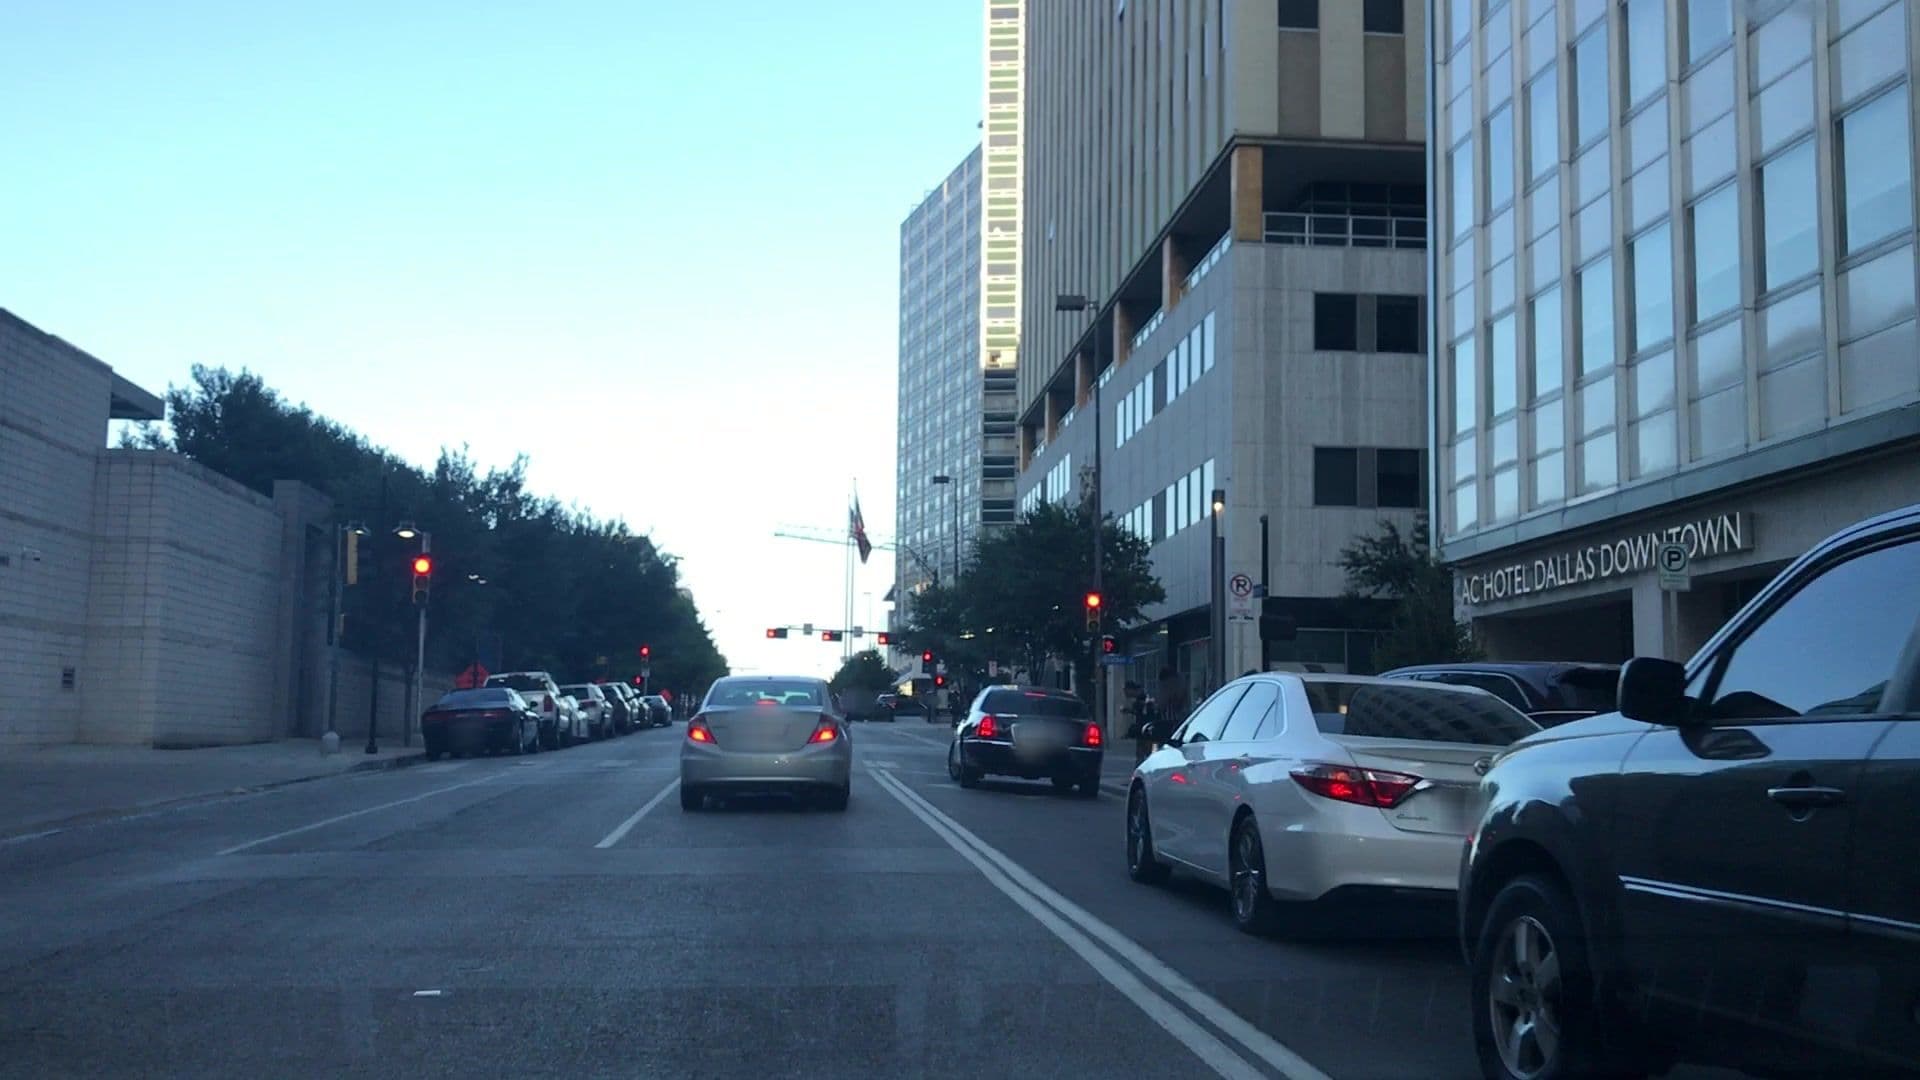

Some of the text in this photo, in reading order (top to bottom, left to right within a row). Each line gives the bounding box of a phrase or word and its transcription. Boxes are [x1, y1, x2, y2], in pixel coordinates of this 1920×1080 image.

[1462, 576, 1481, 605] AC
[1483, 565, 1531, 601] HOTEL
[1534, 546, 1596, 591] DALLAS
[1667, 550, 1682, 567] P
